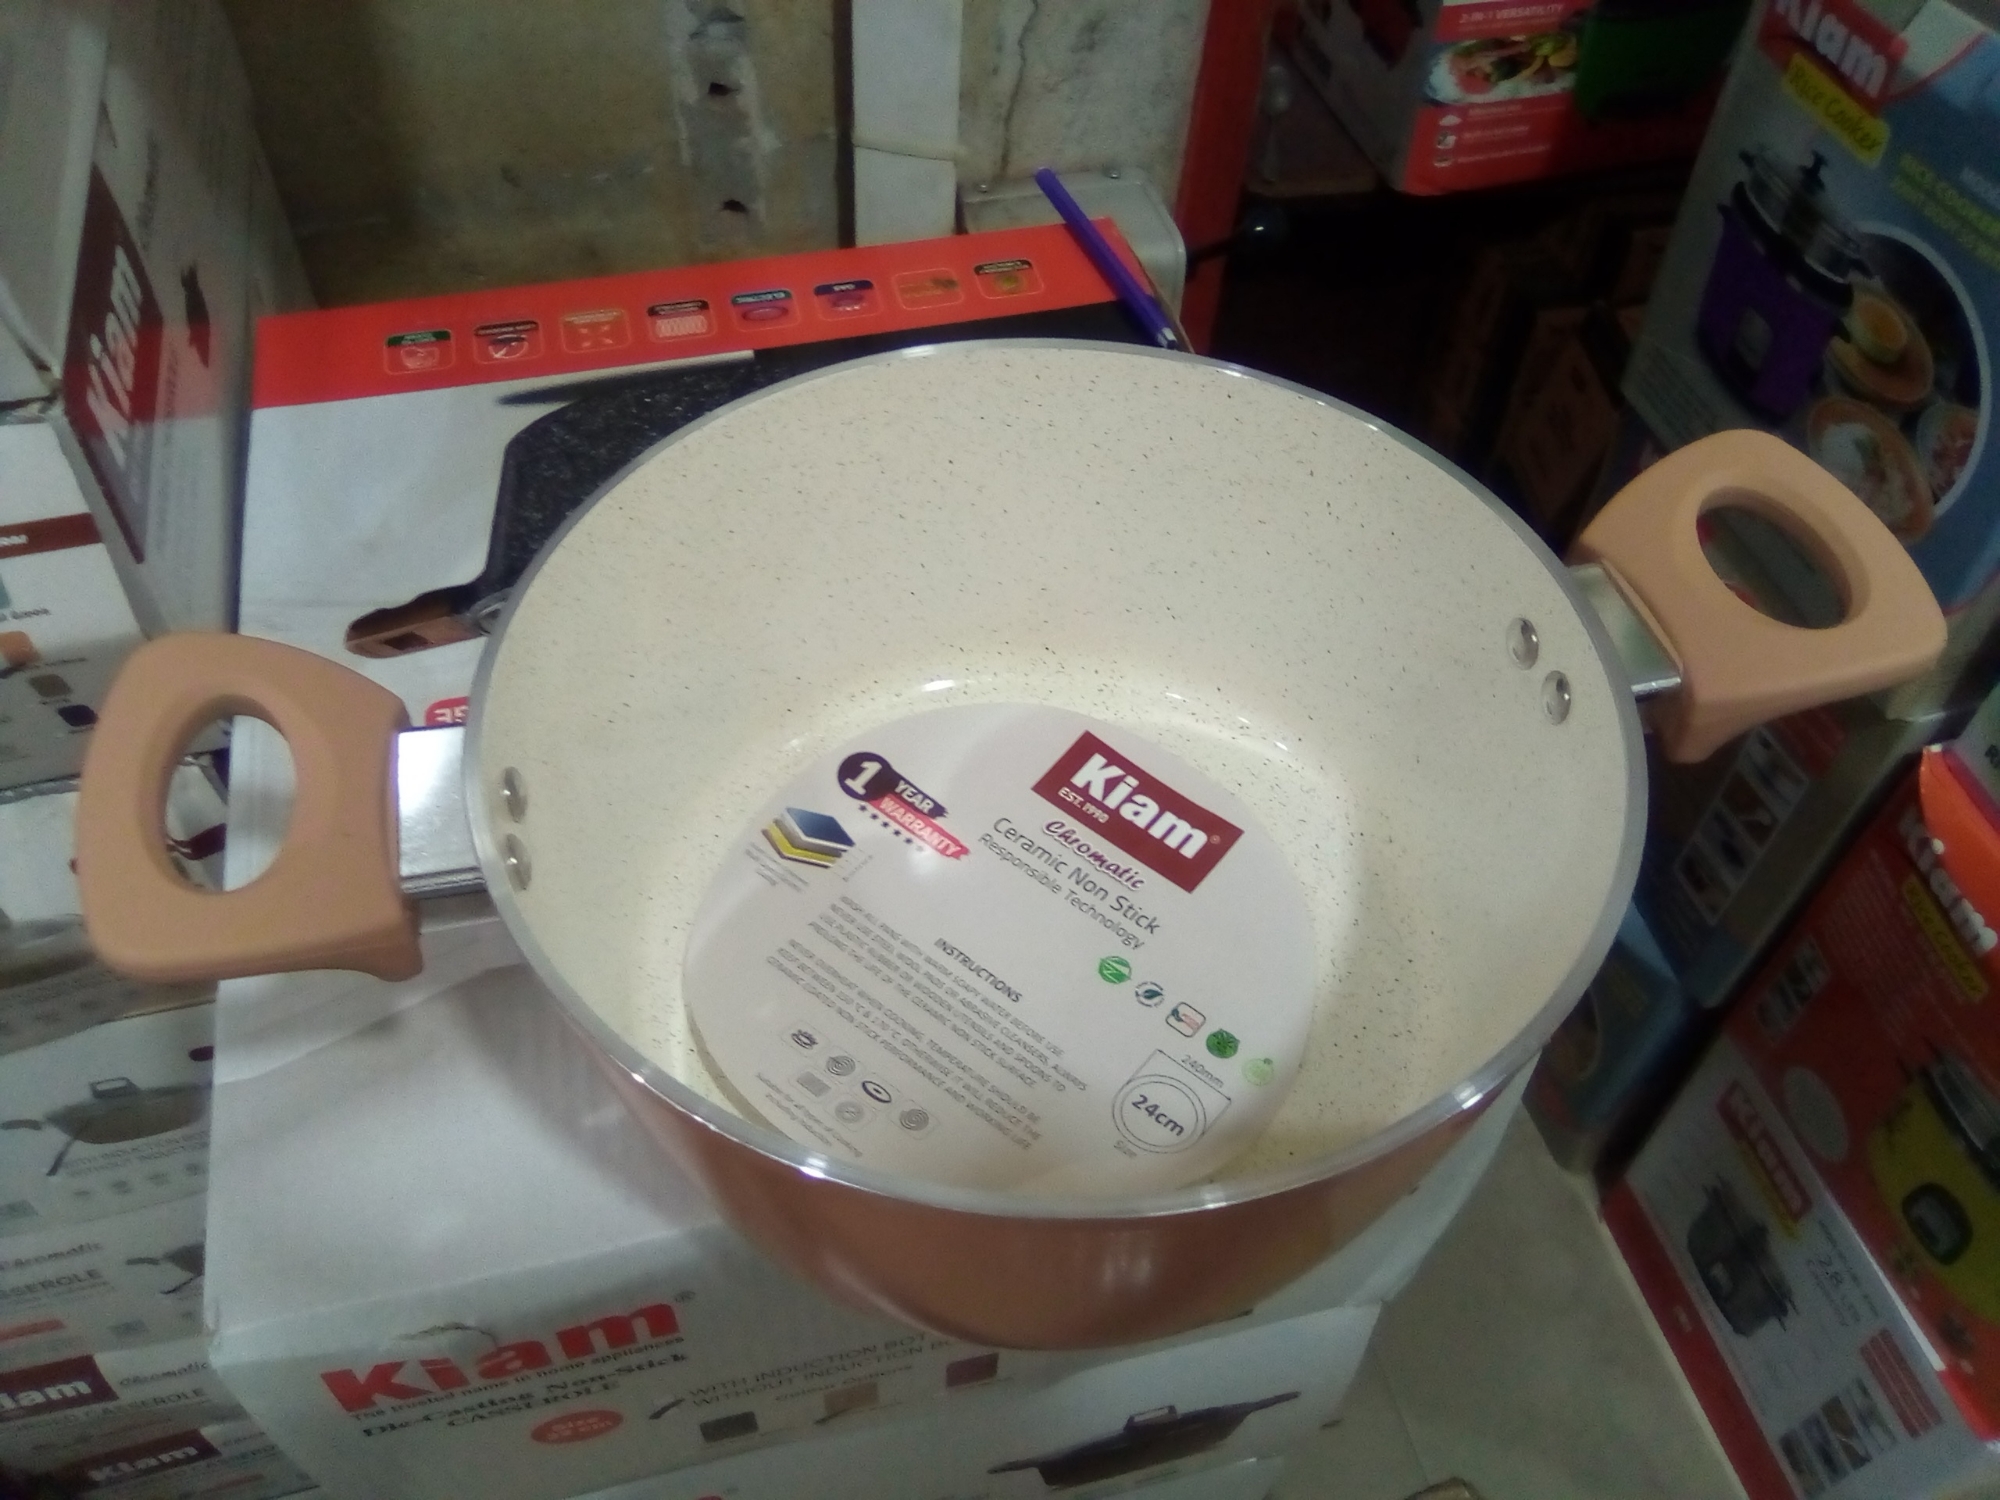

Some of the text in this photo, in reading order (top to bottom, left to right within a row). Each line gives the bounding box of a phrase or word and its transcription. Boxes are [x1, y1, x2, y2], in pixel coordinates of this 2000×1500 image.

[844, 760, 883, 796] 1
[894, 779, 935, 814] YEAR
[1058, 786, 1082, 810] EST.
[1069, 752, 1208, 860] Kiam
[879, 797, 962, 856] WARRANTY
[1044, 820, 1145, 890] Chromatic
[978, 833, 1146, 951] Responsible Technology
[993, 817, 1160, 935] Ceramic Non Stick
[827, 902, 857, 925] NEVER
[894, 952, 924, 973] WOOL
[920, 970, 946, 988] PADS
[957, 996, 1001, 1028] ABRASIVE
[1049, 1062, 1089, 1092] ALWAYS
[845, 948, 865, 963] THE
[909, 995, 951, 1025] CERAMIC
[948, 1023, 973, 1041] NON
[969, 1039, 998, 1059] STICK
[898, 938, 925, 957] WITH
[951, 975, 981, 997] SOAPY
[979, 995, 1012, 1019] WATER
[1009, 1017, 1045, 1043] BEFORE
[933, 937, 1025, 1004] INSTRUCTIONS
[763, 955, 805, 985] CERAMIC
[834, 1006, 857, 1023] NON
[877, 1038, 945, 1087] PERFORMANCE
[942, 1085, 966, 1103] AND
[964, 1101, 1013, 1136] WORKING
[1008, 1133, 1032, 1150] LIFE
[786, 938, 815, 960] NEVER
[813, 958, 858, 991] OVERHEAT
[855, 989, 885, 1010] WHEN
[924, 1039, 990, 1087] TEMPERATURE
[986, 1084, 1029, 1115] SHOULD
[1025, 1112, 1041, 1123] BE
[911, 980, 955, 1011] WOODEN
[951, 1008, 996, 1041] UTENSILS
[991, 1038, 1015, 1055] AND
[1012, 1053, 1053, 1082] SPOONS
[1049, 1079, 1067, 1092] TO
[1181, 1053, 1225, 1089] 240mm
[960, 1082, 986, 1100] WILL
[982, 1097, 1023, 1127] REDUCE
[1020, 1124, 1042, 1141] THE
[1131, 1094, 1185, 1137] 24cm
[320, 1302, 680, 1413] Kiam
[460, 1380, 510, 1397] name
[589, 1337, 685, 1367] appliances
[546, 1353, 689, 1392] Non-Stick
[689, 1376, 747, 1398] WITH
[755, 1344, 876, 1382] INDUCTION
[692, 1376, 793, 1408] WITHOUT
[803, 1343, 924, 1381] INDUCTION
